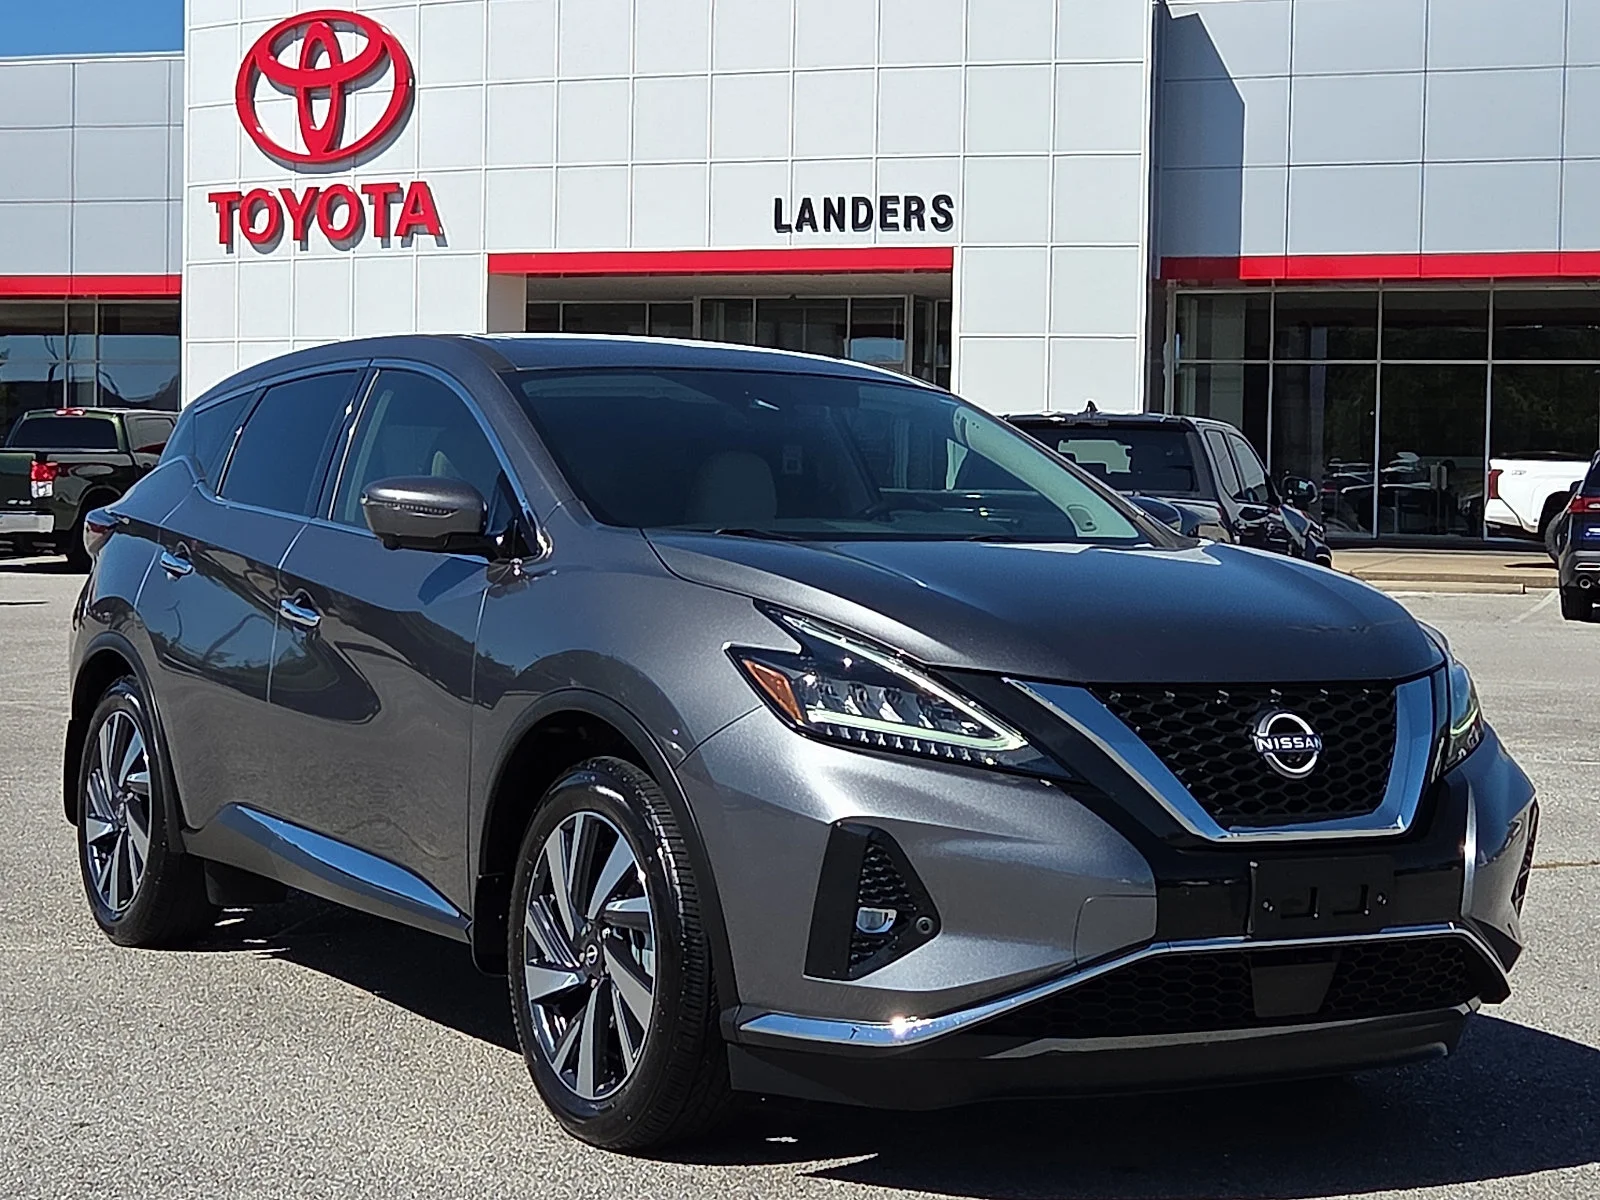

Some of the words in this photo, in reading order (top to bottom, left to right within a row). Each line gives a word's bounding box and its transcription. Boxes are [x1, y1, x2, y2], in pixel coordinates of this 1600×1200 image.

[208, 181, 443, 246] TOYOTA
[774, 194, 954, 233] LANDERS
[1257, 736, 1321, 750] NISSAN
